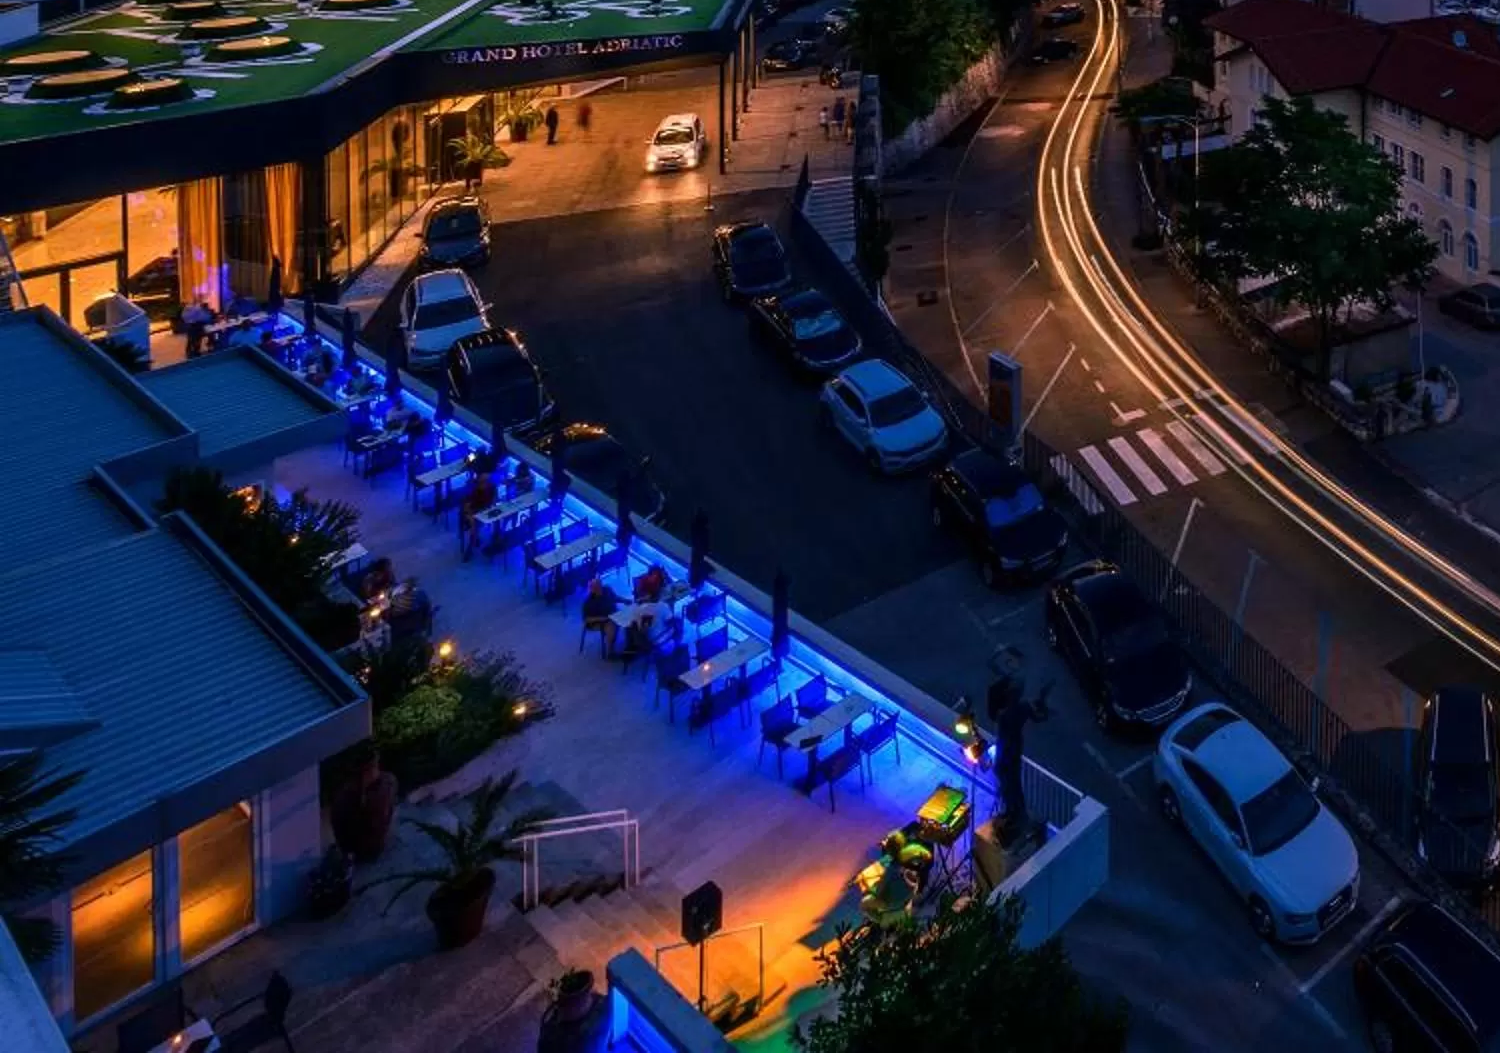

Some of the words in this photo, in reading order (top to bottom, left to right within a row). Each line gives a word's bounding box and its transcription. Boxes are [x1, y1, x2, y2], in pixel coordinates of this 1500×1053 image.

[442, 47, 518, 64] GRAND
[522, 42, 589, 60] HOTEL
[592, 35, 684, 54] ADRIATIC
